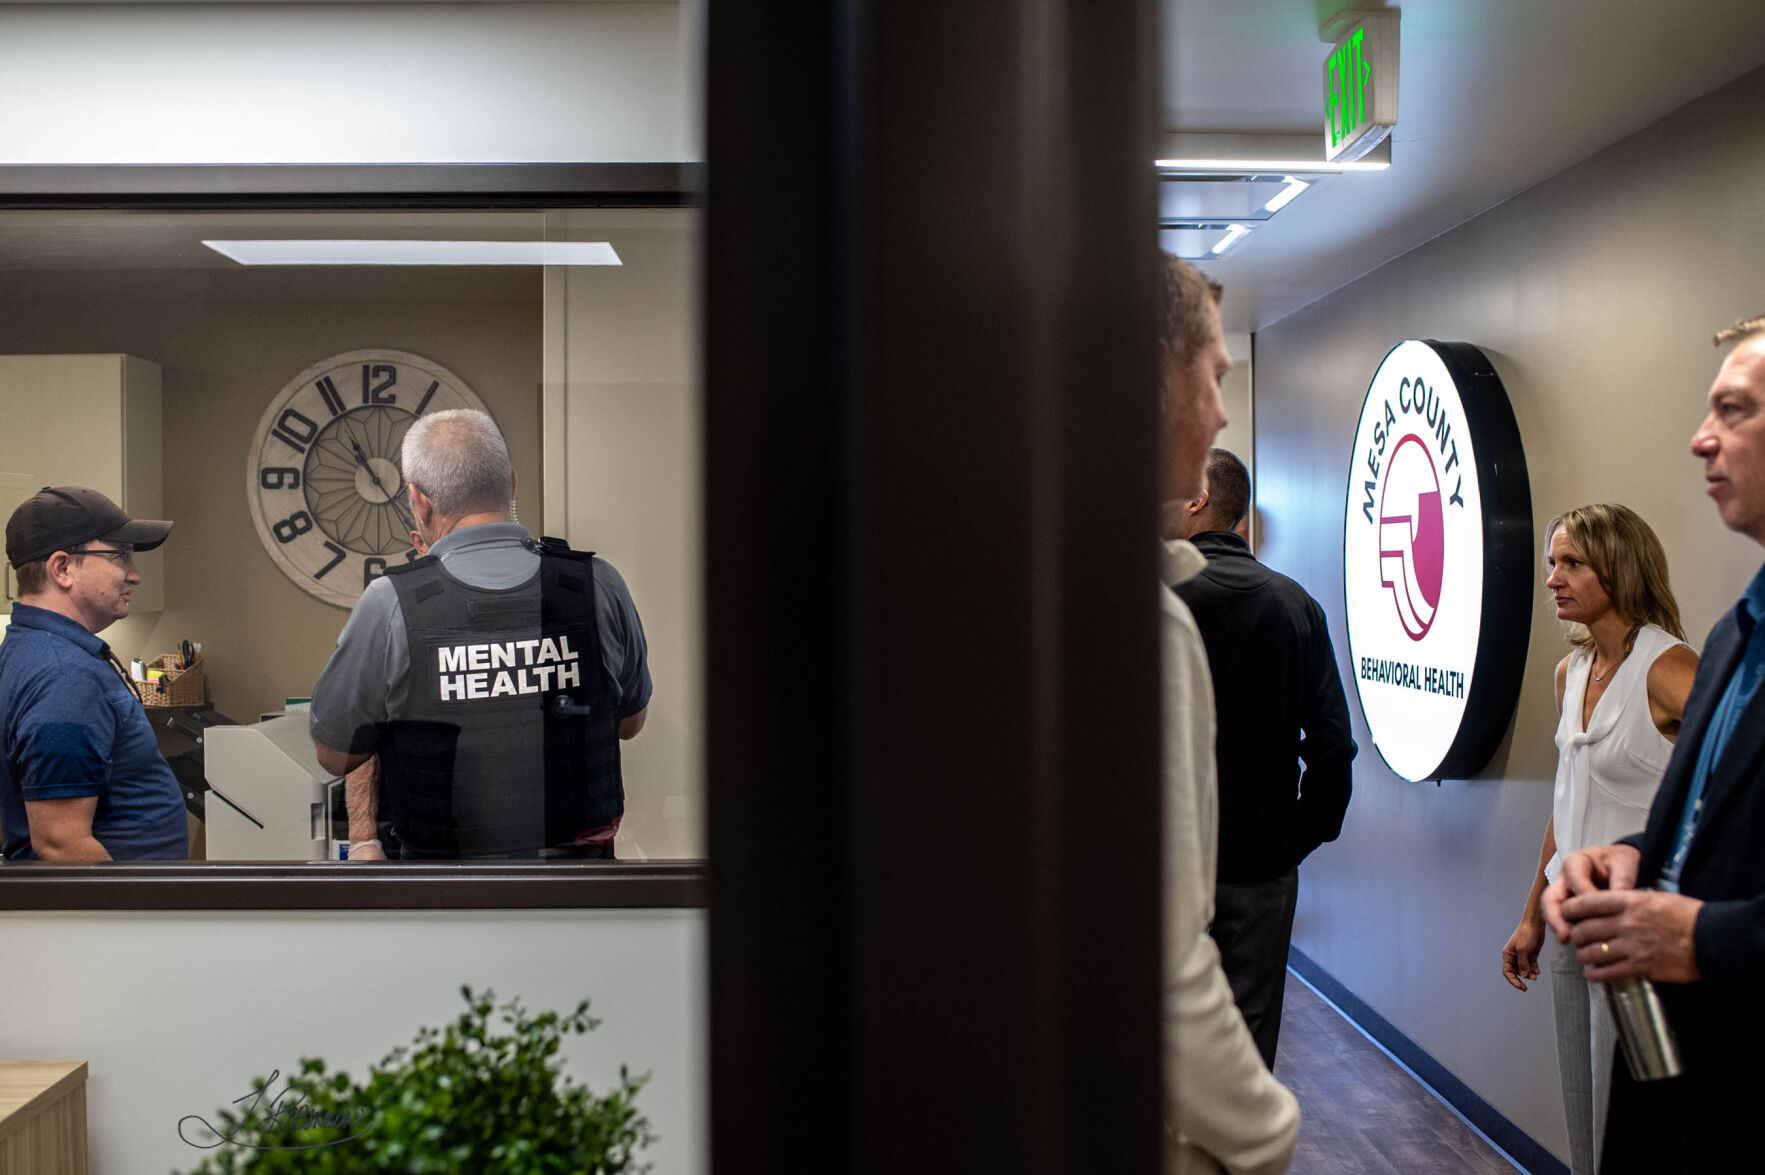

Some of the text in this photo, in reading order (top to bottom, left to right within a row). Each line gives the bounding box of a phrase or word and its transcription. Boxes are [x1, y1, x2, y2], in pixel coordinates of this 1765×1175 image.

[1328, 27, 1365, 148] EXIT
[362, 364, 397, 404] 12
[271, 408, 318, 454] 10
[1363, 376, 1464, 525] MESA COUNTY
[273, 510, 313, 544] 8
[313, 540, 347, 580] 7
[438, 635, 579, 672] MENTAL
[439, 661, 581, 701] HEALTH
[1361, 656, 1464, 699] BEHAVIORAL HEALTH
